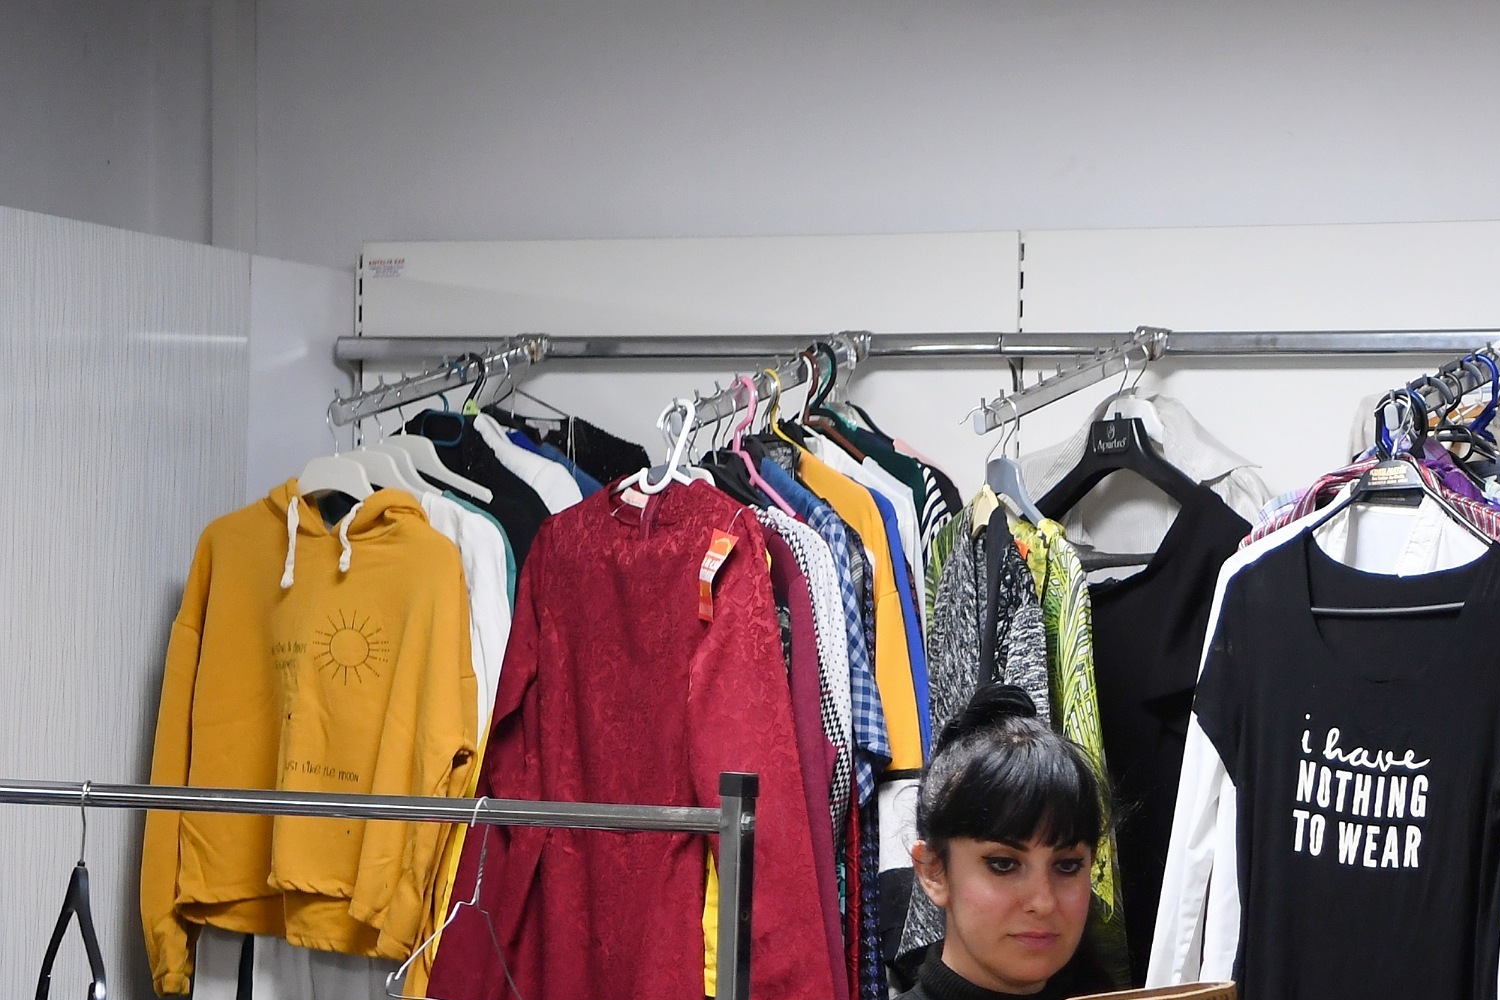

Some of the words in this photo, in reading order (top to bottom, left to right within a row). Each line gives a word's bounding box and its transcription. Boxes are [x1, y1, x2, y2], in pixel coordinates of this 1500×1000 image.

[1301, 712, 1313, 754] i
[1322, 727, 1431, 772] have
[1296, 759, 1429, 818] NOTHING
[1293, 809, 1326, 856] TO
[1338, 821, 1422, 868] WEAR
